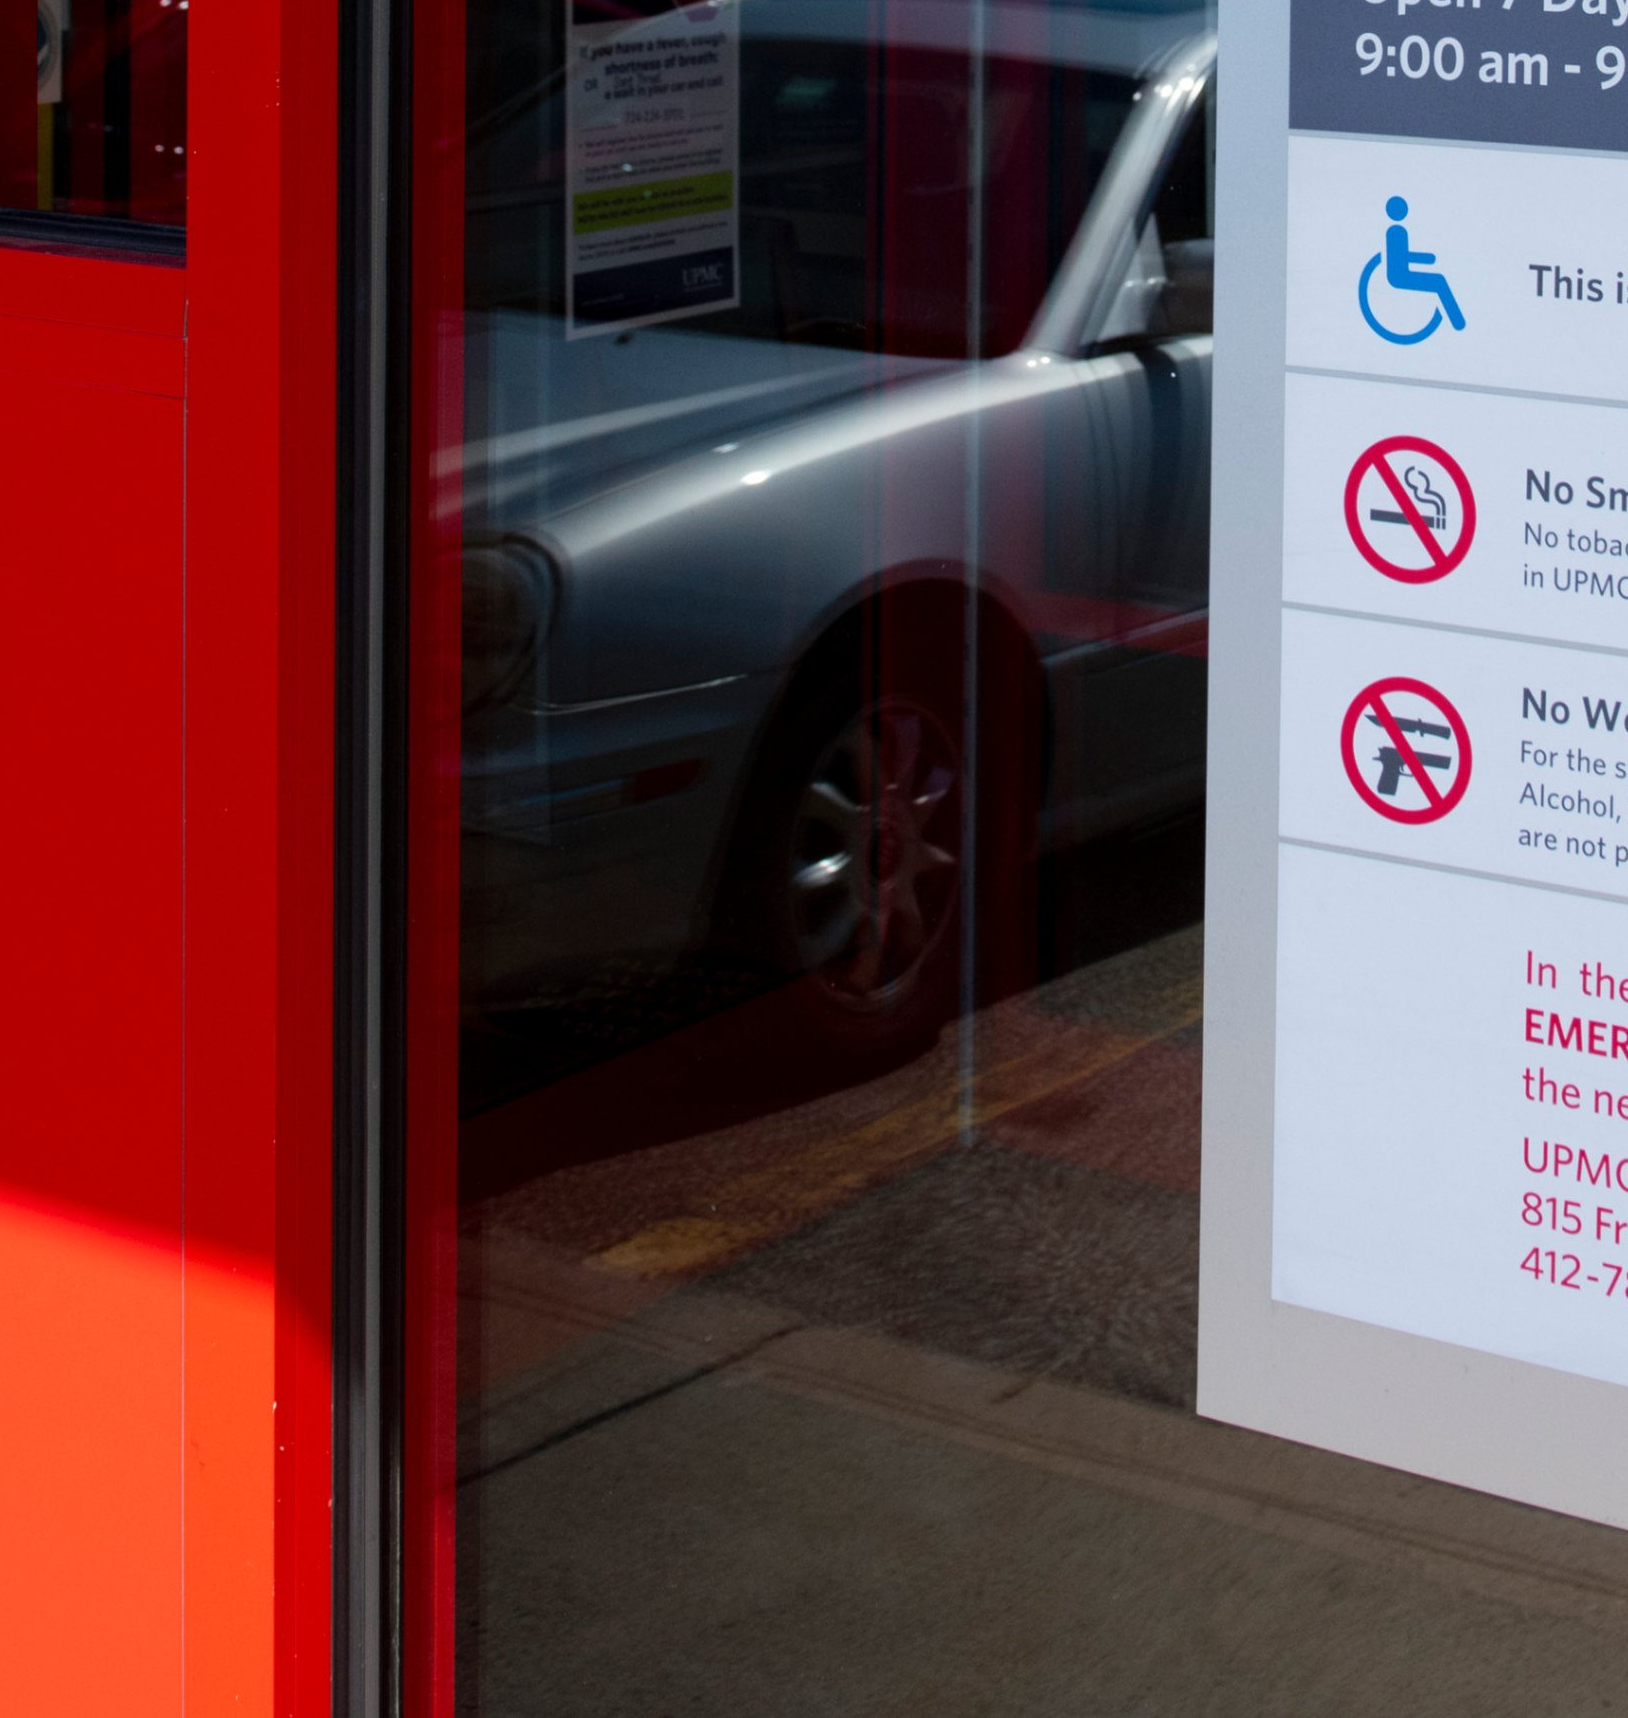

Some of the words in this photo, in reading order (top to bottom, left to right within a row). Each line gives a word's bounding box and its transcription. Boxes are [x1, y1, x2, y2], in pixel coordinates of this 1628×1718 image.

[1356, 33, 1464, 80] 9:00
[1479, 51, 1548, 85] am
[1529, 264, 1603, 302] This
[1526, 469, 1573, 505] No
[1525, 522, 1558, 548] No
[1524, 564, 1543, 588] in
[1523, 688, 1570, 724] No
[1521, 740, 1558, 767] For
[1567, 748, 1606, 775] the
[1520, 782, 1620, 823] Alcohol,
[1519, 829, 1557, 850] are
[1567, 837, 1606, 859] not
[1527, 950, 1556, 989] In
[1523, 1067, 1580, 1109] the
[1522, 1192, 1582, 1234] 815
